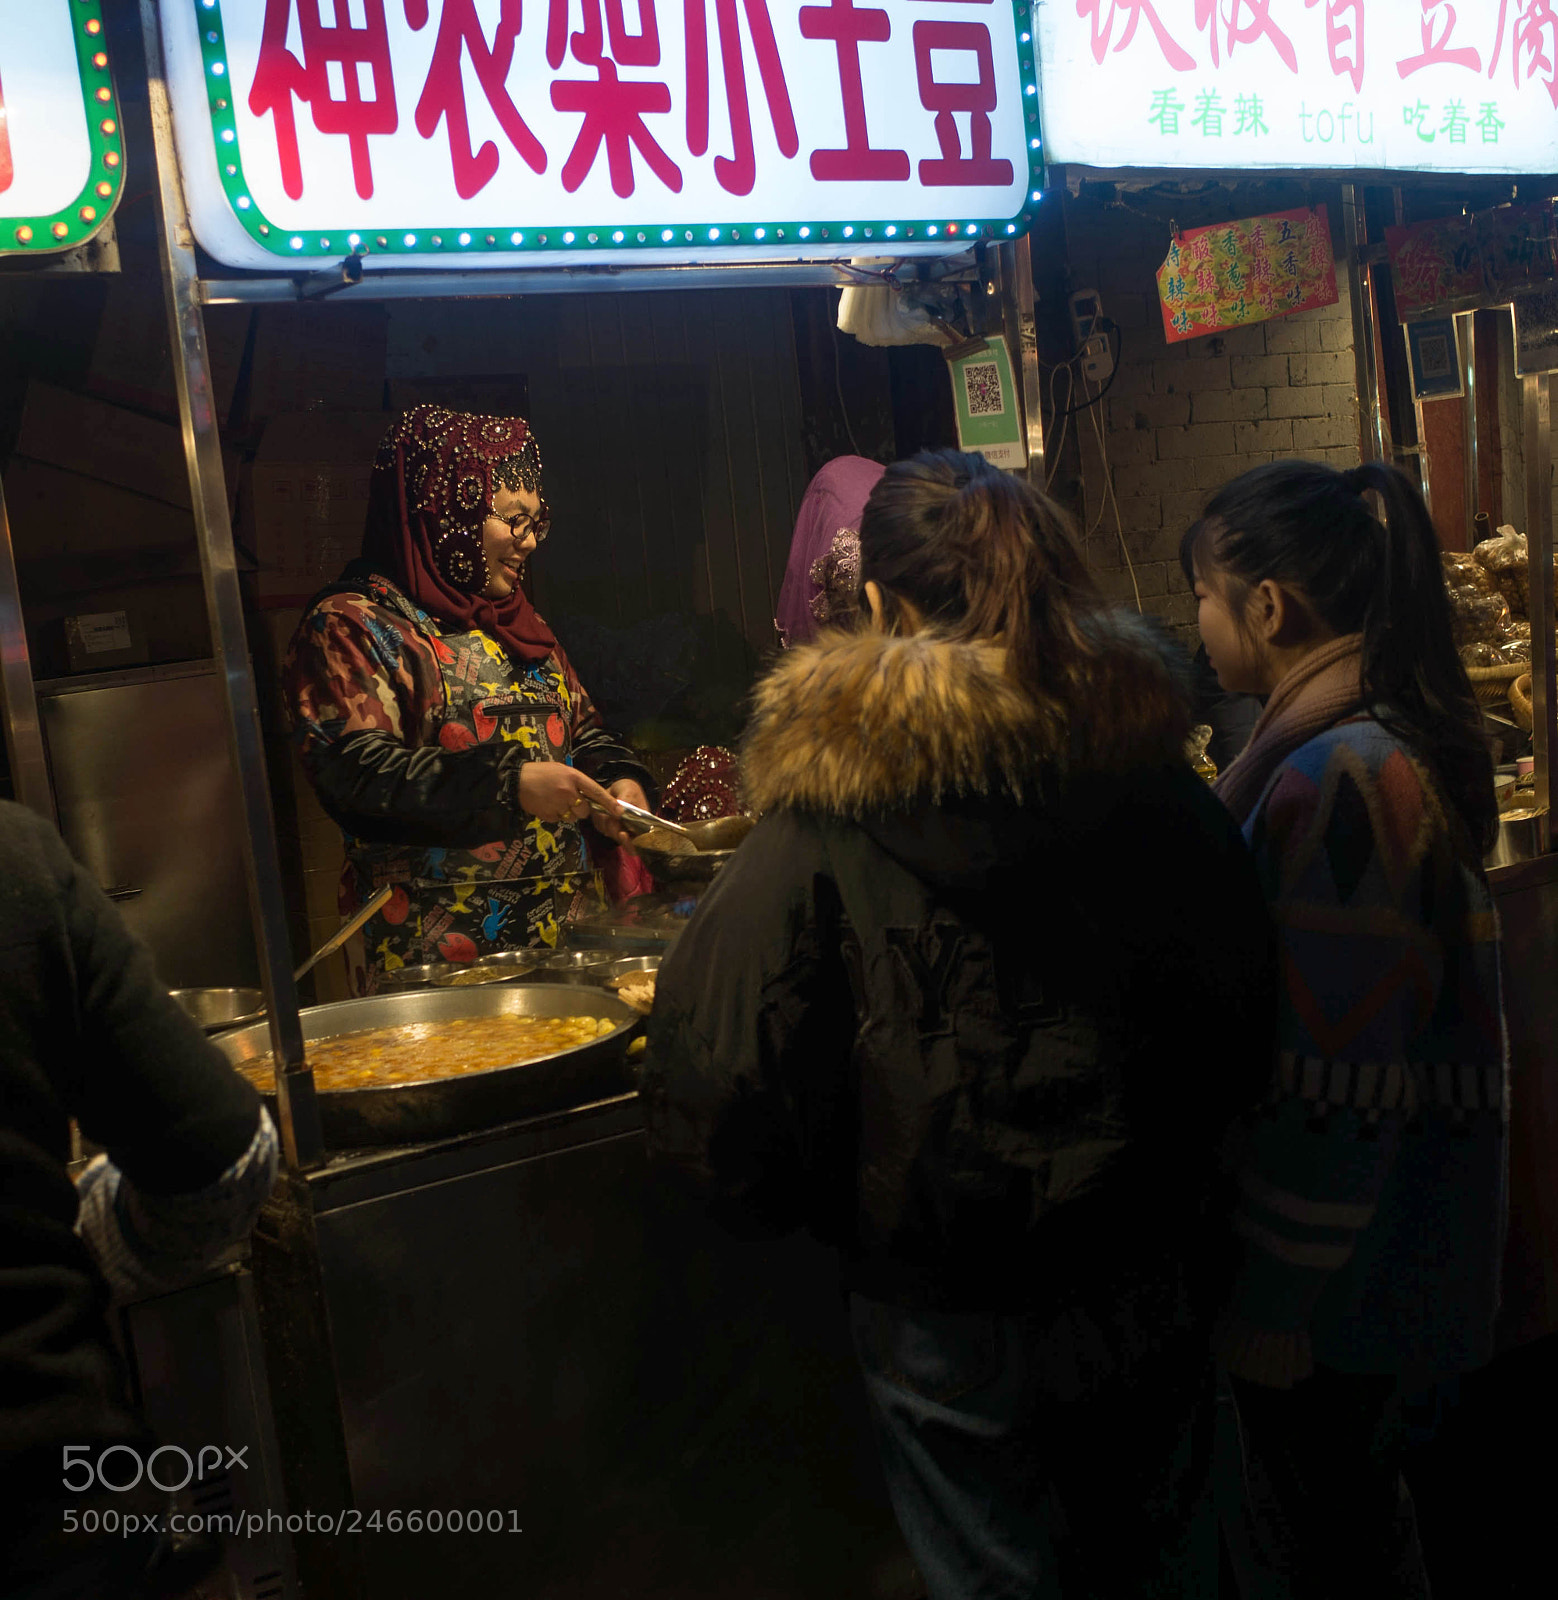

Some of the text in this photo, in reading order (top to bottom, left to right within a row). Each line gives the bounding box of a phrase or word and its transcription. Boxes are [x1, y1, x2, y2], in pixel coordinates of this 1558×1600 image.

[1147, 87, 1270, 138] 看着辣
[1299, 101, 1374, 144] tofu
[1402, 98, 1506, 144] 吃着香
